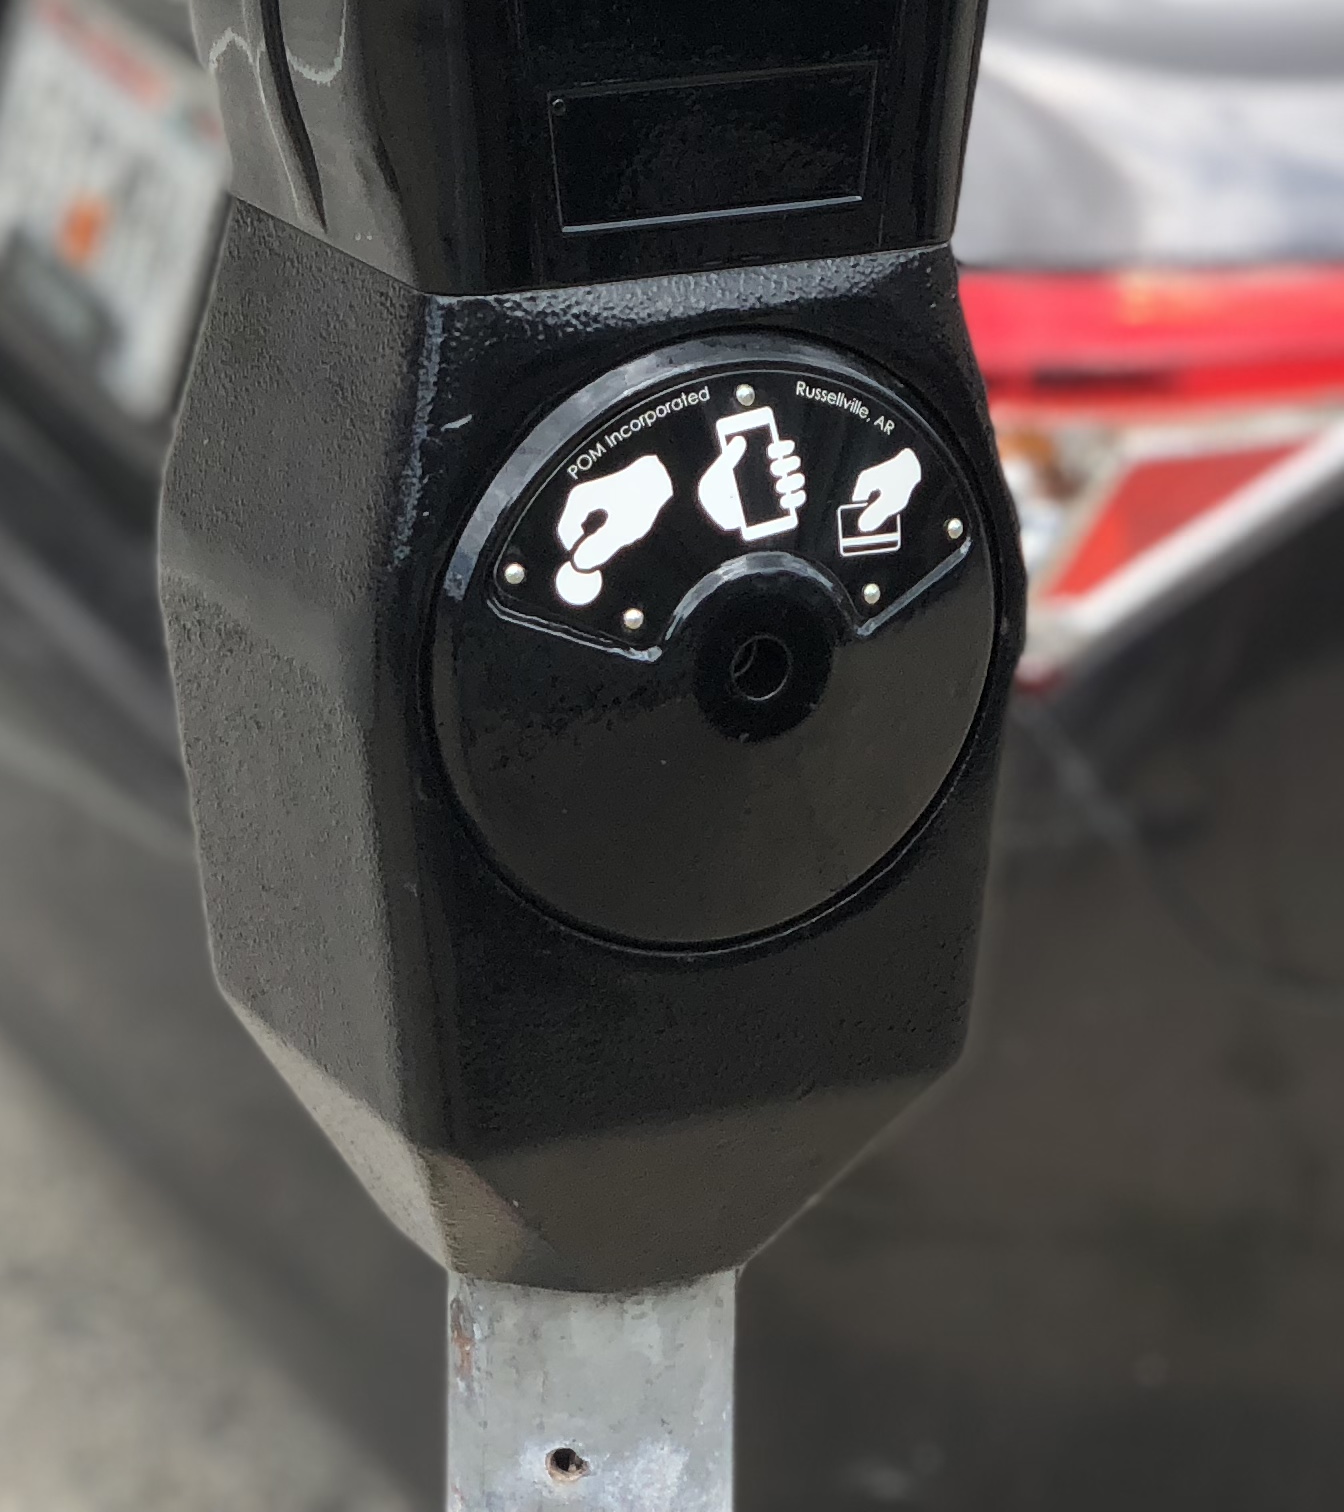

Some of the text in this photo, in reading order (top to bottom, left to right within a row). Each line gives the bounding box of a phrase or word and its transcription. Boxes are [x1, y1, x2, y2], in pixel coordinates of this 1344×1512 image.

[566, 385, 711, 480] POM Incorporated
[796, 380, 896, 436] Russellville, AR
